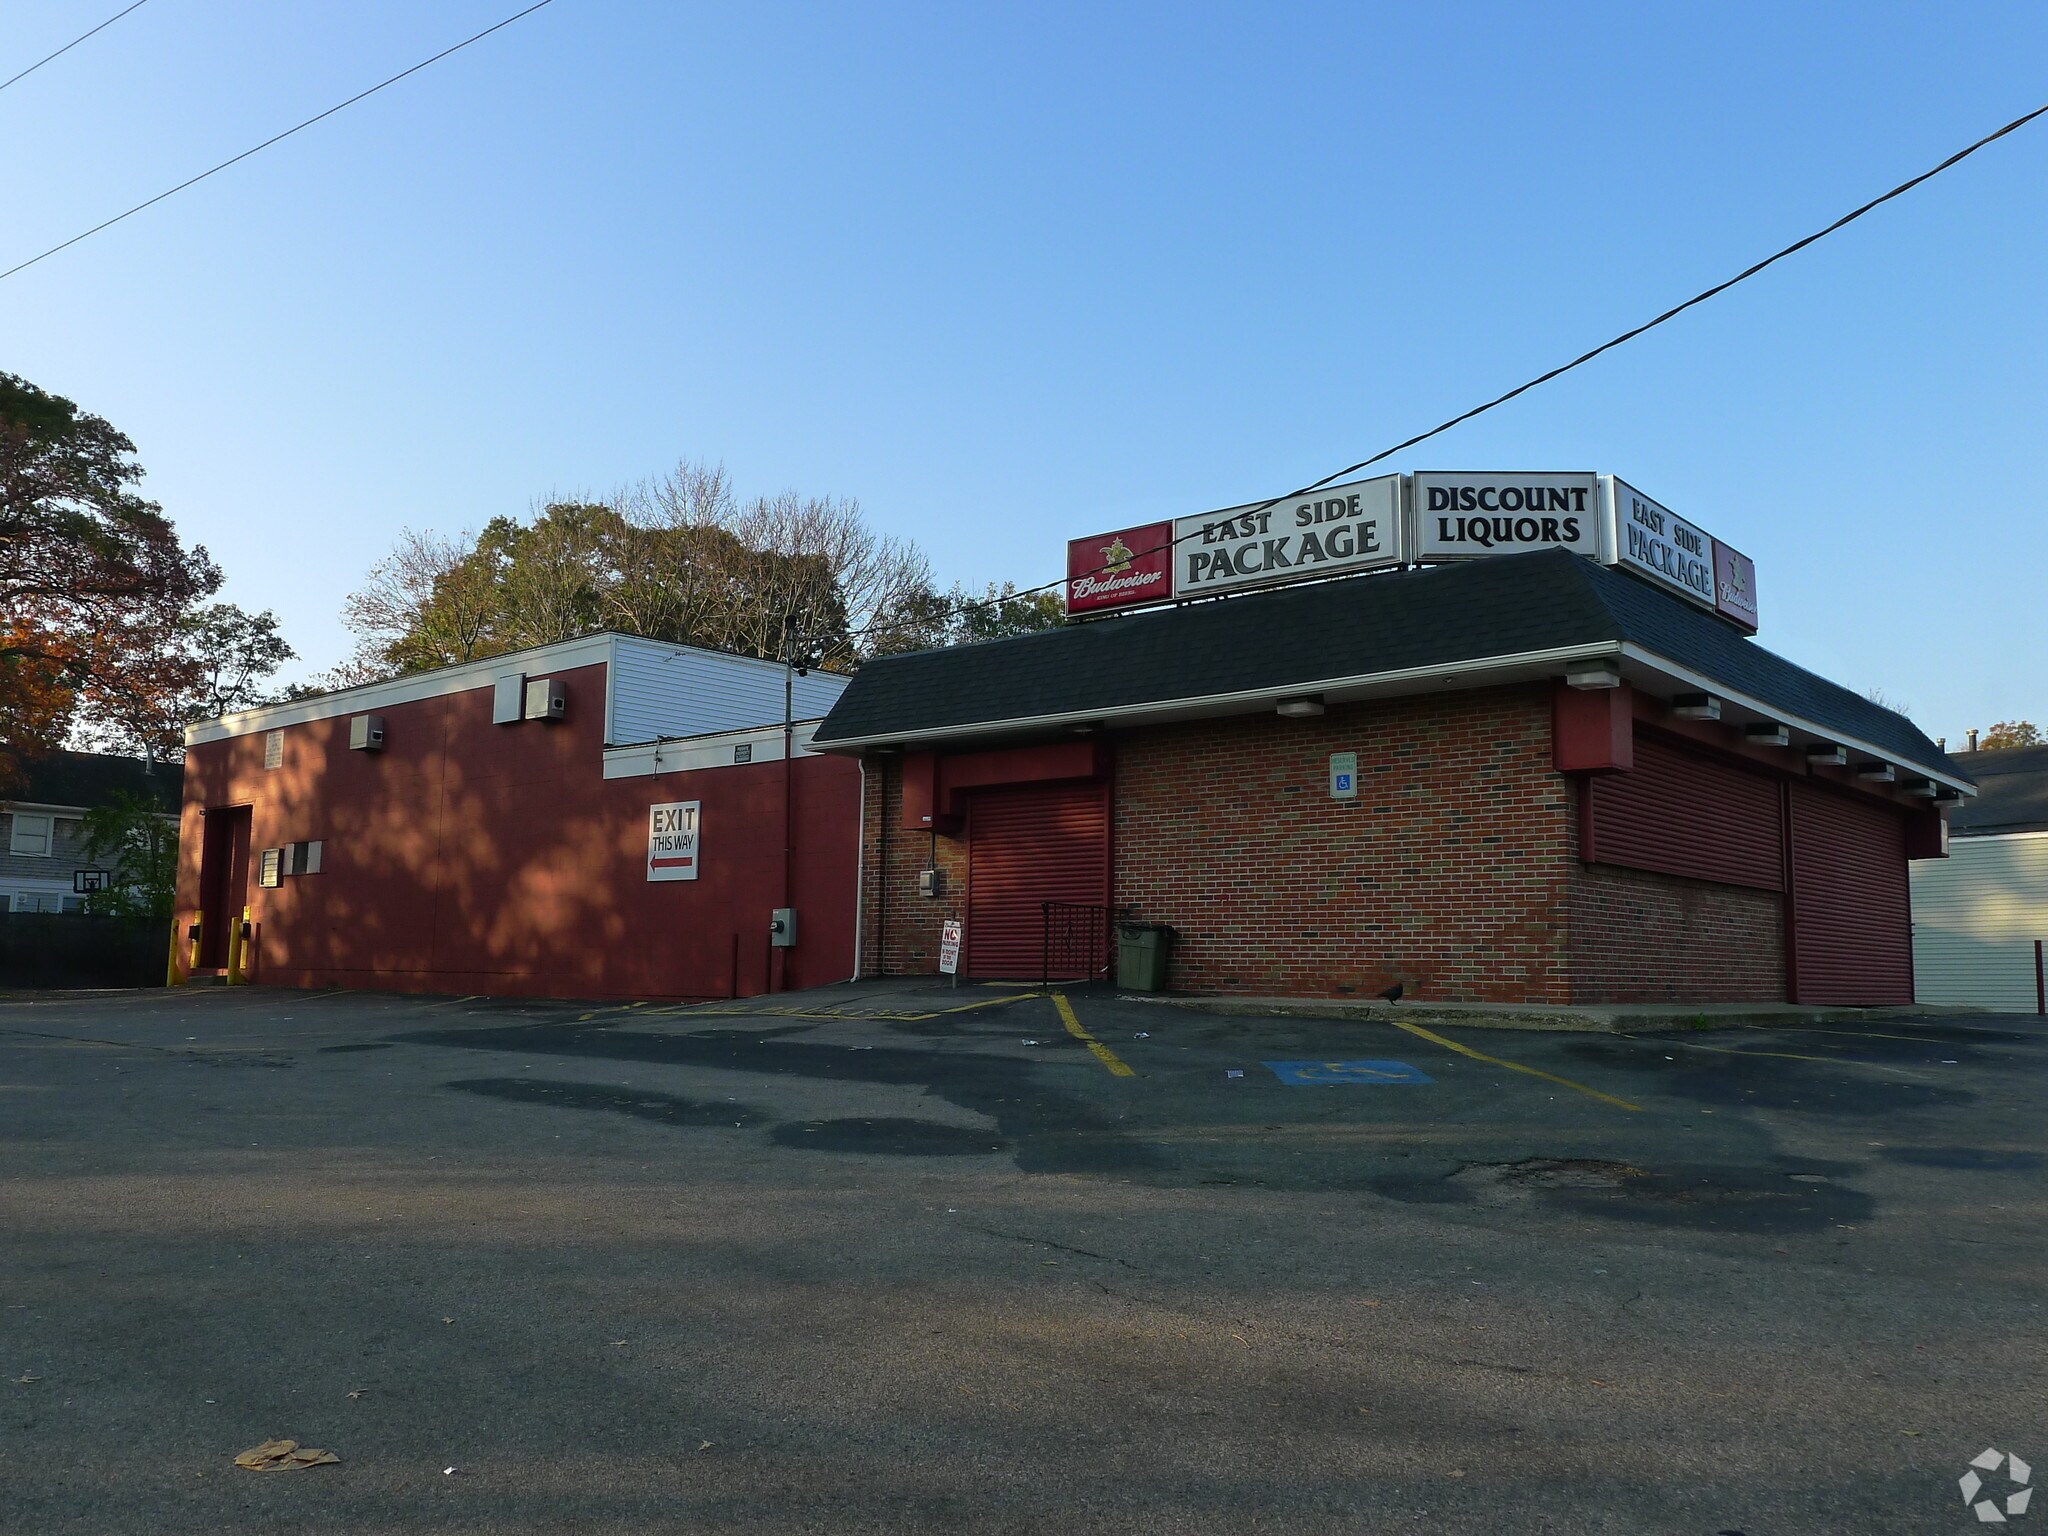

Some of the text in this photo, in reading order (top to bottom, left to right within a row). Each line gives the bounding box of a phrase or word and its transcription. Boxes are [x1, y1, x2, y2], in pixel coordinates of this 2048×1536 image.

[1427, 486, 1588, 512] DISCOUNT
[1202, 493, 1363, 545] EAST SIDE
[1438, 517, 1581, 547] LIQUORS
[1632, 497, 1703, 558] EAST SIDE
[1187, 520, 1381, 584] PACKAGE
[1627, 522, 1712, 597] PACKAGE
[1072, 571, 1161, 599] Budweiser
[653, 808, 695, 833] EXIT
[652, 834, 694, 851] THIS WAY
[944, 929, 958, 940] NO
